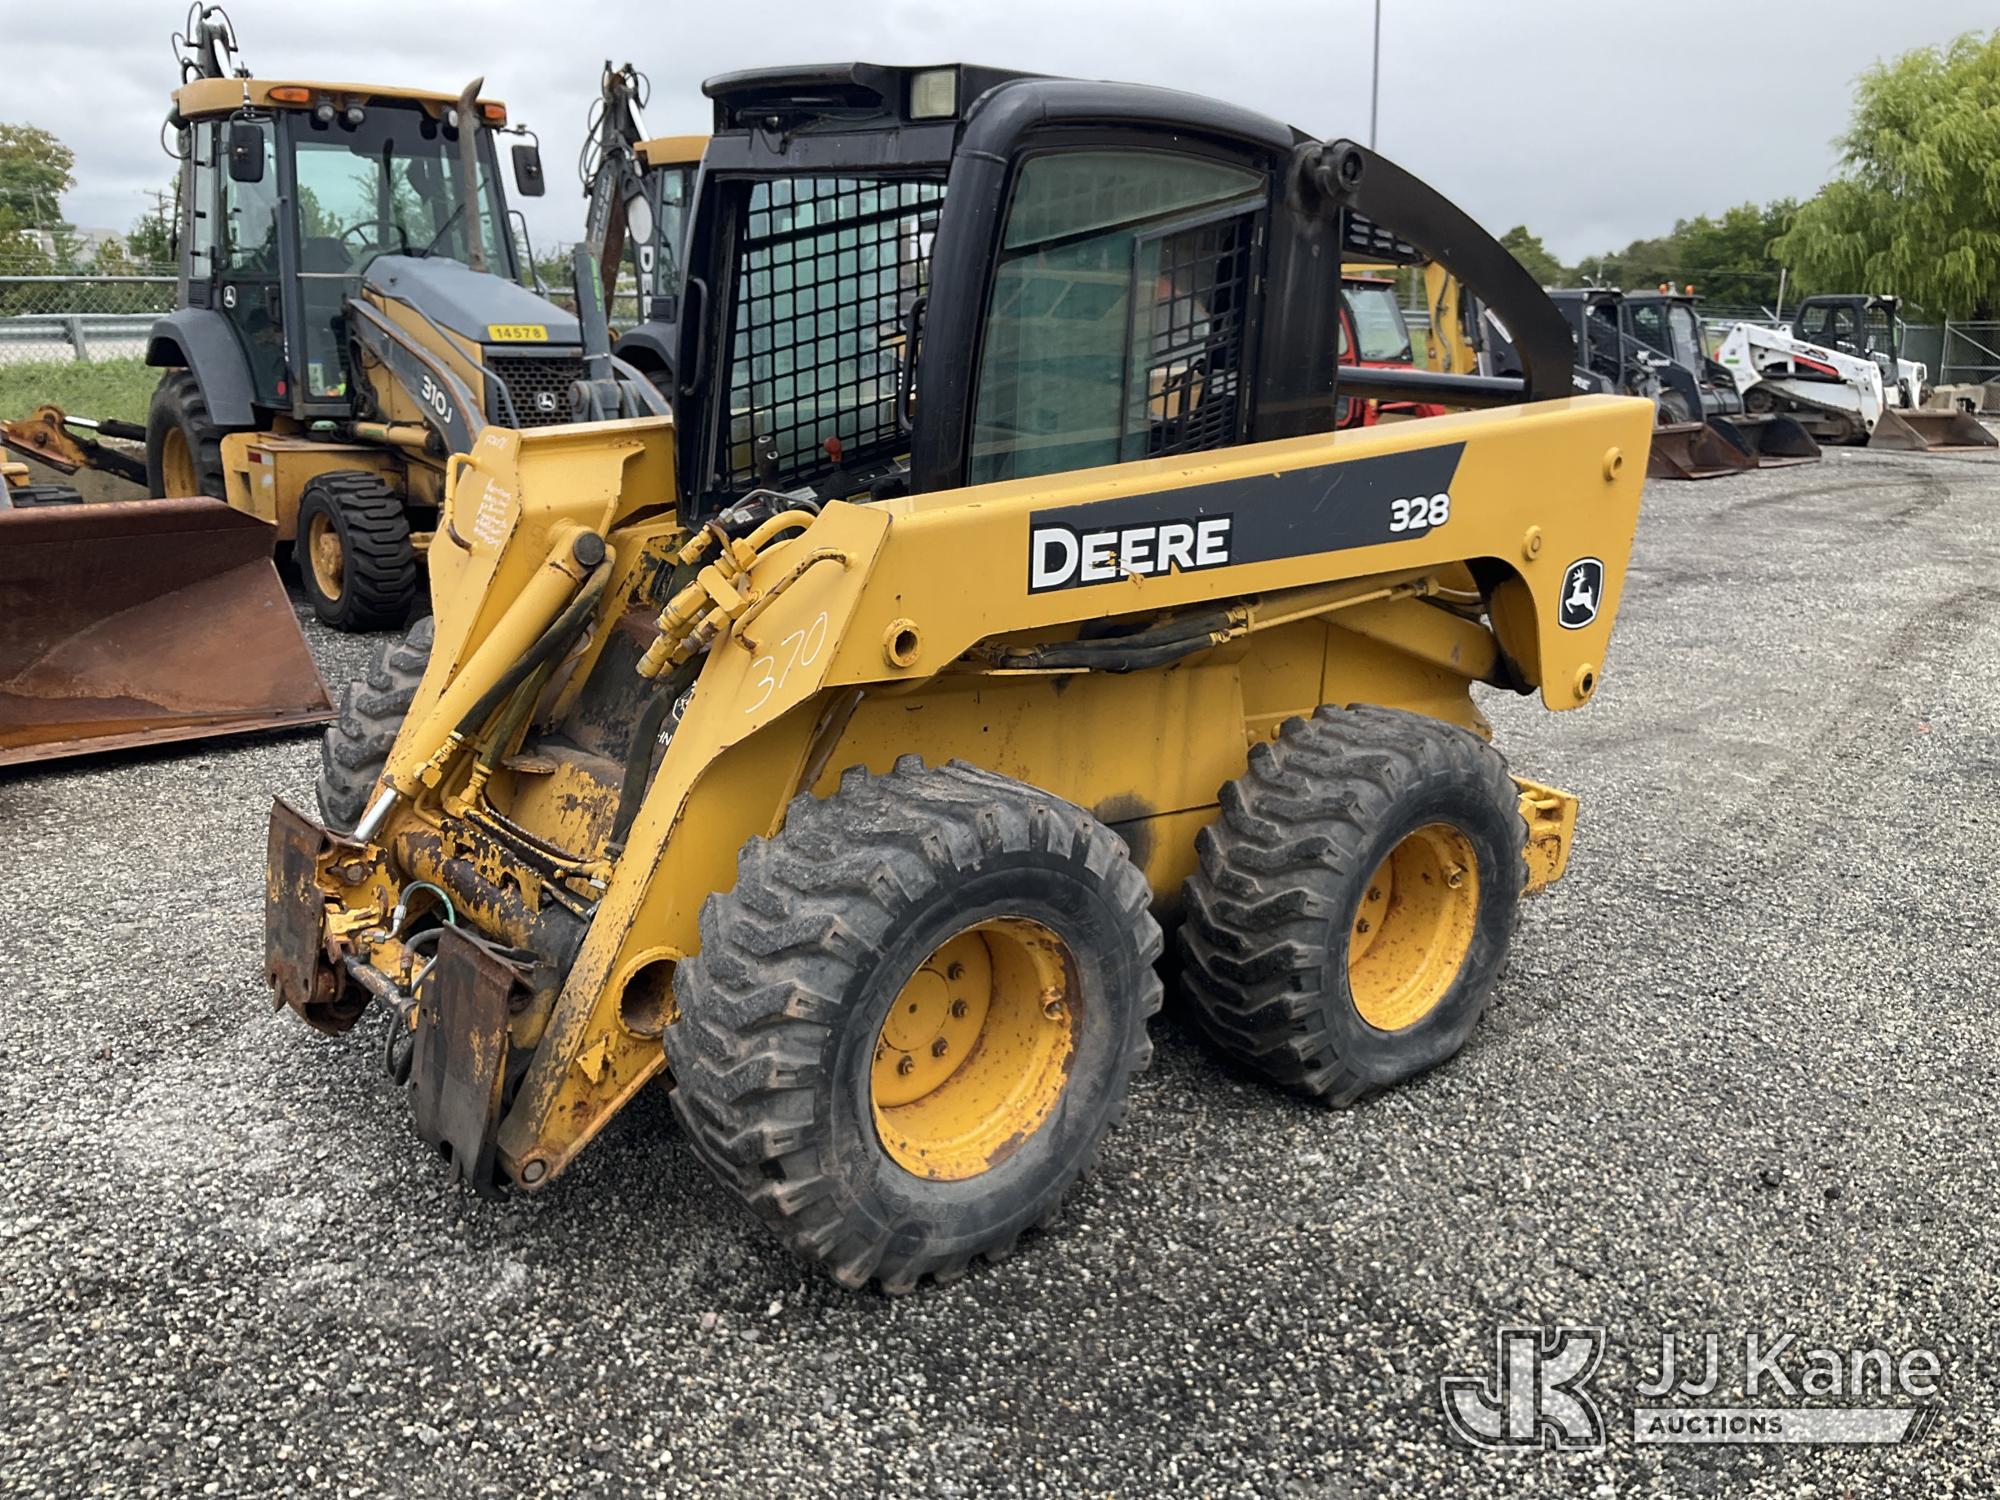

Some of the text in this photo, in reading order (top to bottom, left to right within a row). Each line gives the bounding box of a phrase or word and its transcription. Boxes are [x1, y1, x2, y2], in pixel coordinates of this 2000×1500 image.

[639, 246, 655, 325] DEE
[421, 375, 453, 424] 310J
[1389, 493, 1450, 532] 328
[1032, 518, 1231, 589] DEERE
[745, 611, 828, 713] 370
